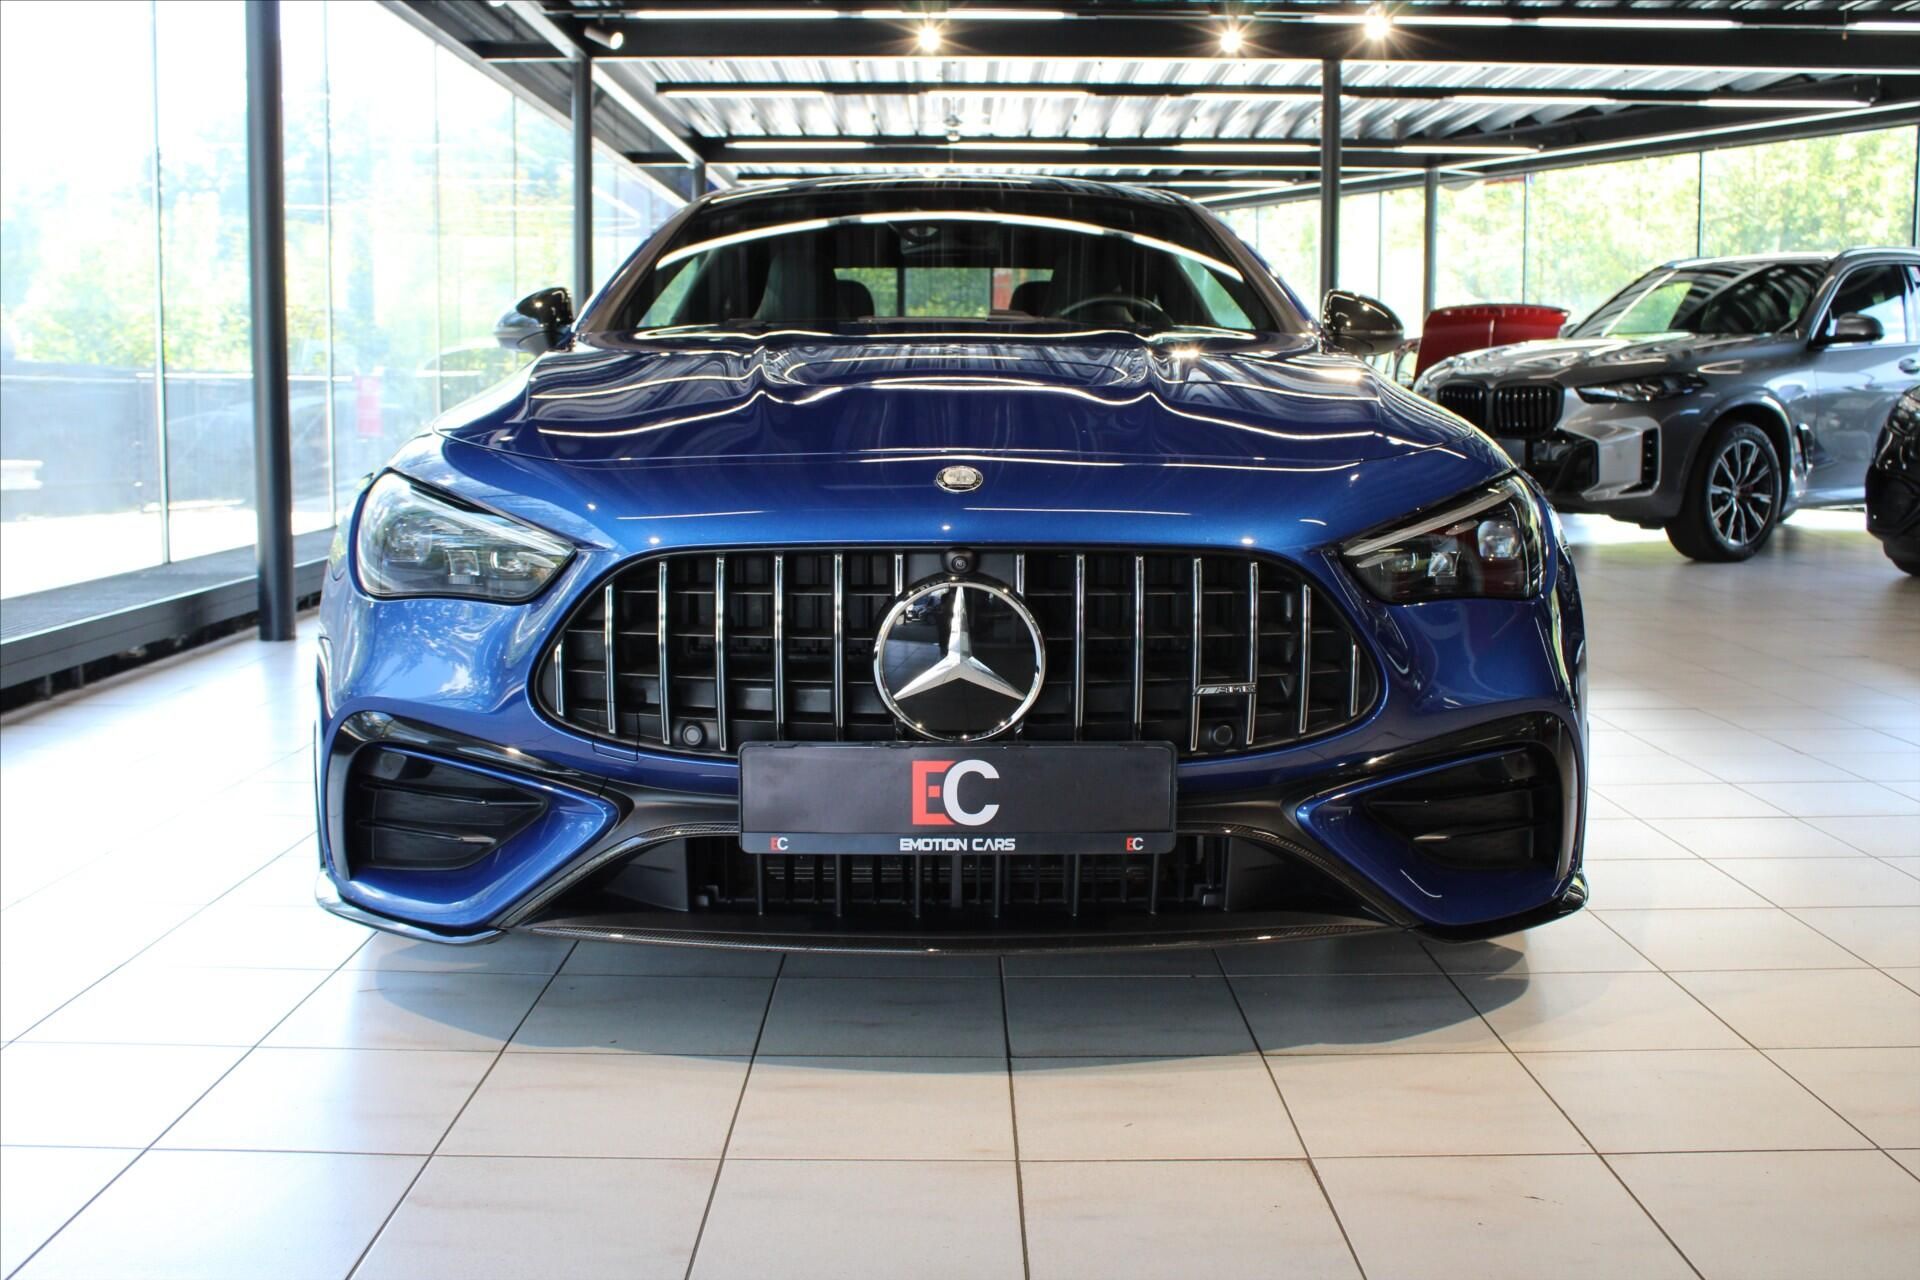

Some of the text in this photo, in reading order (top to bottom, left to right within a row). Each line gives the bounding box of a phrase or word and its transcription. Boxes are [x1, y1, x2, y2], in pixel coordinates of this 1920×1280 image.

[912, 759, 1000, 826] EC
[770, 836, 789, 851] EC
[899, 838, 1016, 851] EMOTION CARS
[1126, 836, 1145, 851] EC
